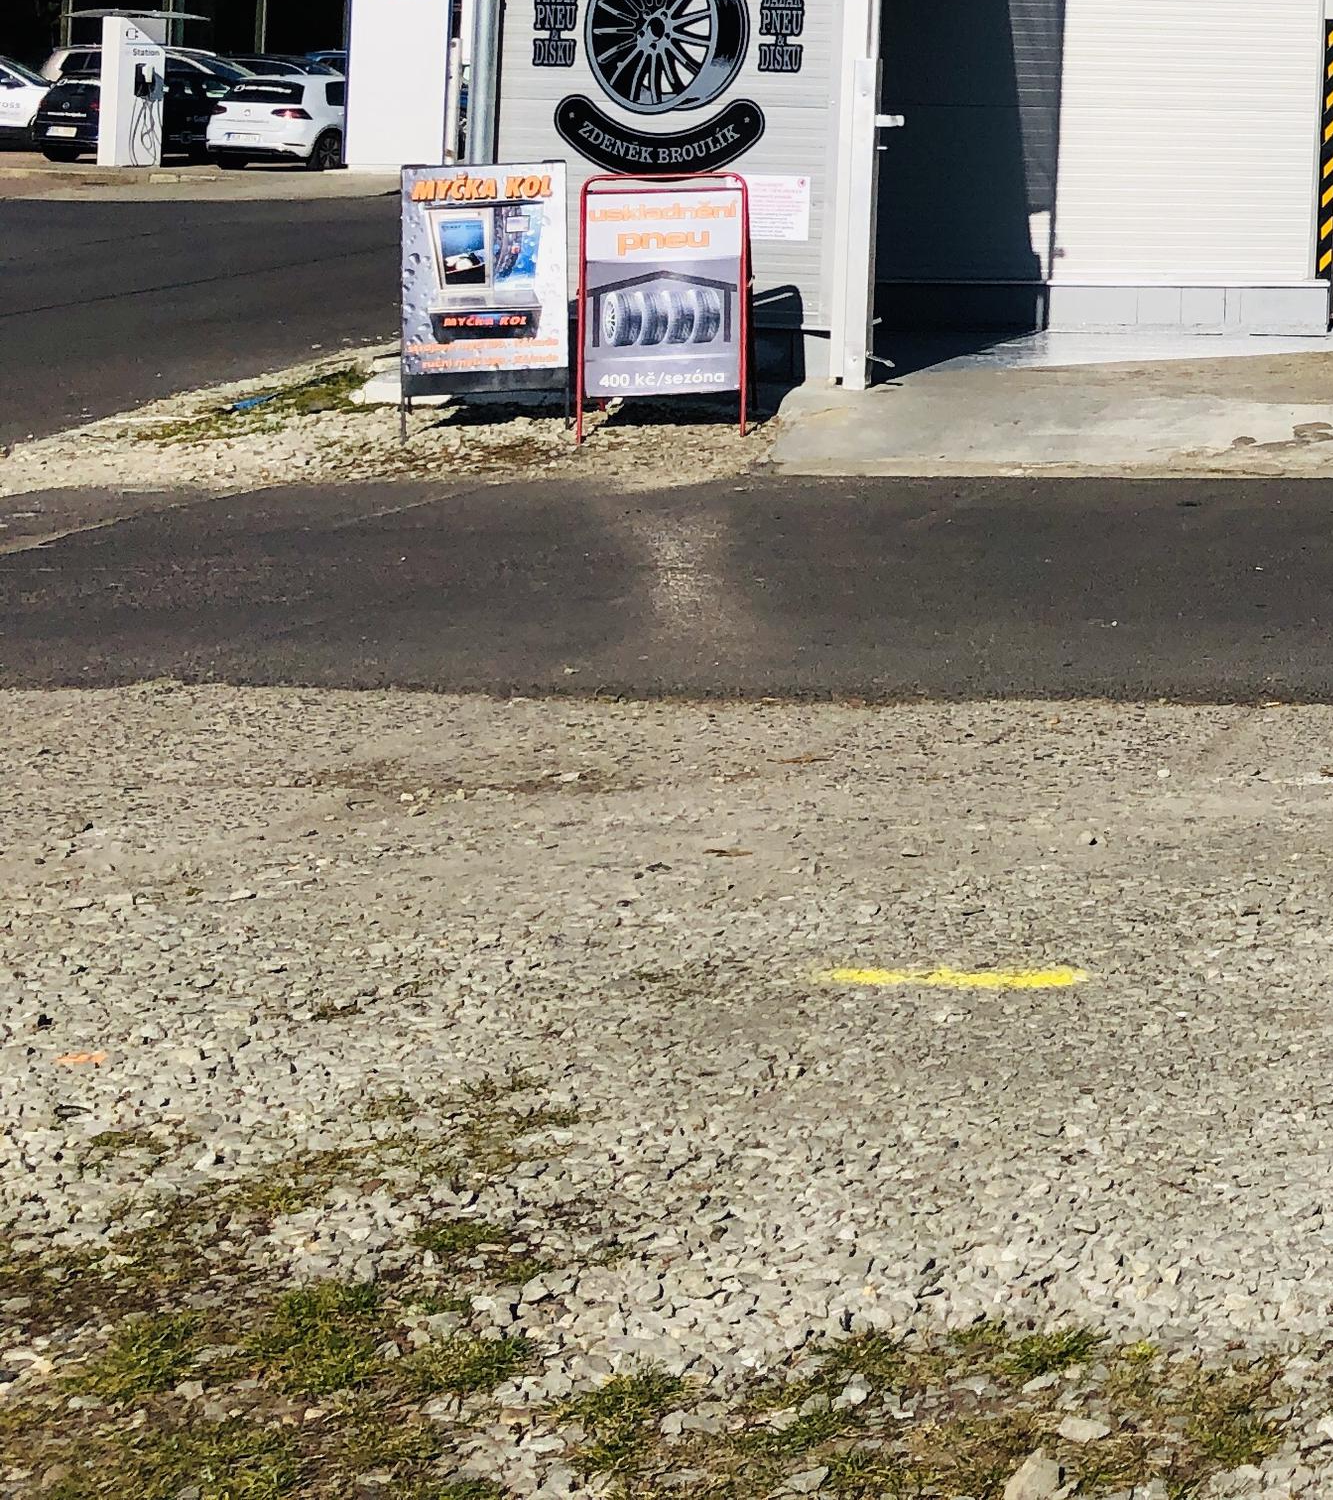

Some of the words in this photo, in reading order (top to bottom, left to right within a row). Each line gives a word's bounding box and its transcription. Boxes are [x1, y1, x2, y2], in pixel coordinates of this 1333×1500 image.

[534, 5, 576, 29] PNEU
[761, 10, 802, 35] PNEU
[657, 124, 741, 164] BROULÍK
[411, 171, 498, 202] MYČKA
[505, 174, 553, 199] KOL
[588, 199, 738, 223] uskladnění
[617, 230, 710, 256] pneu
[599, 371, 630, 388] 400
[635, 368, 726, 388] kč/sezóna
